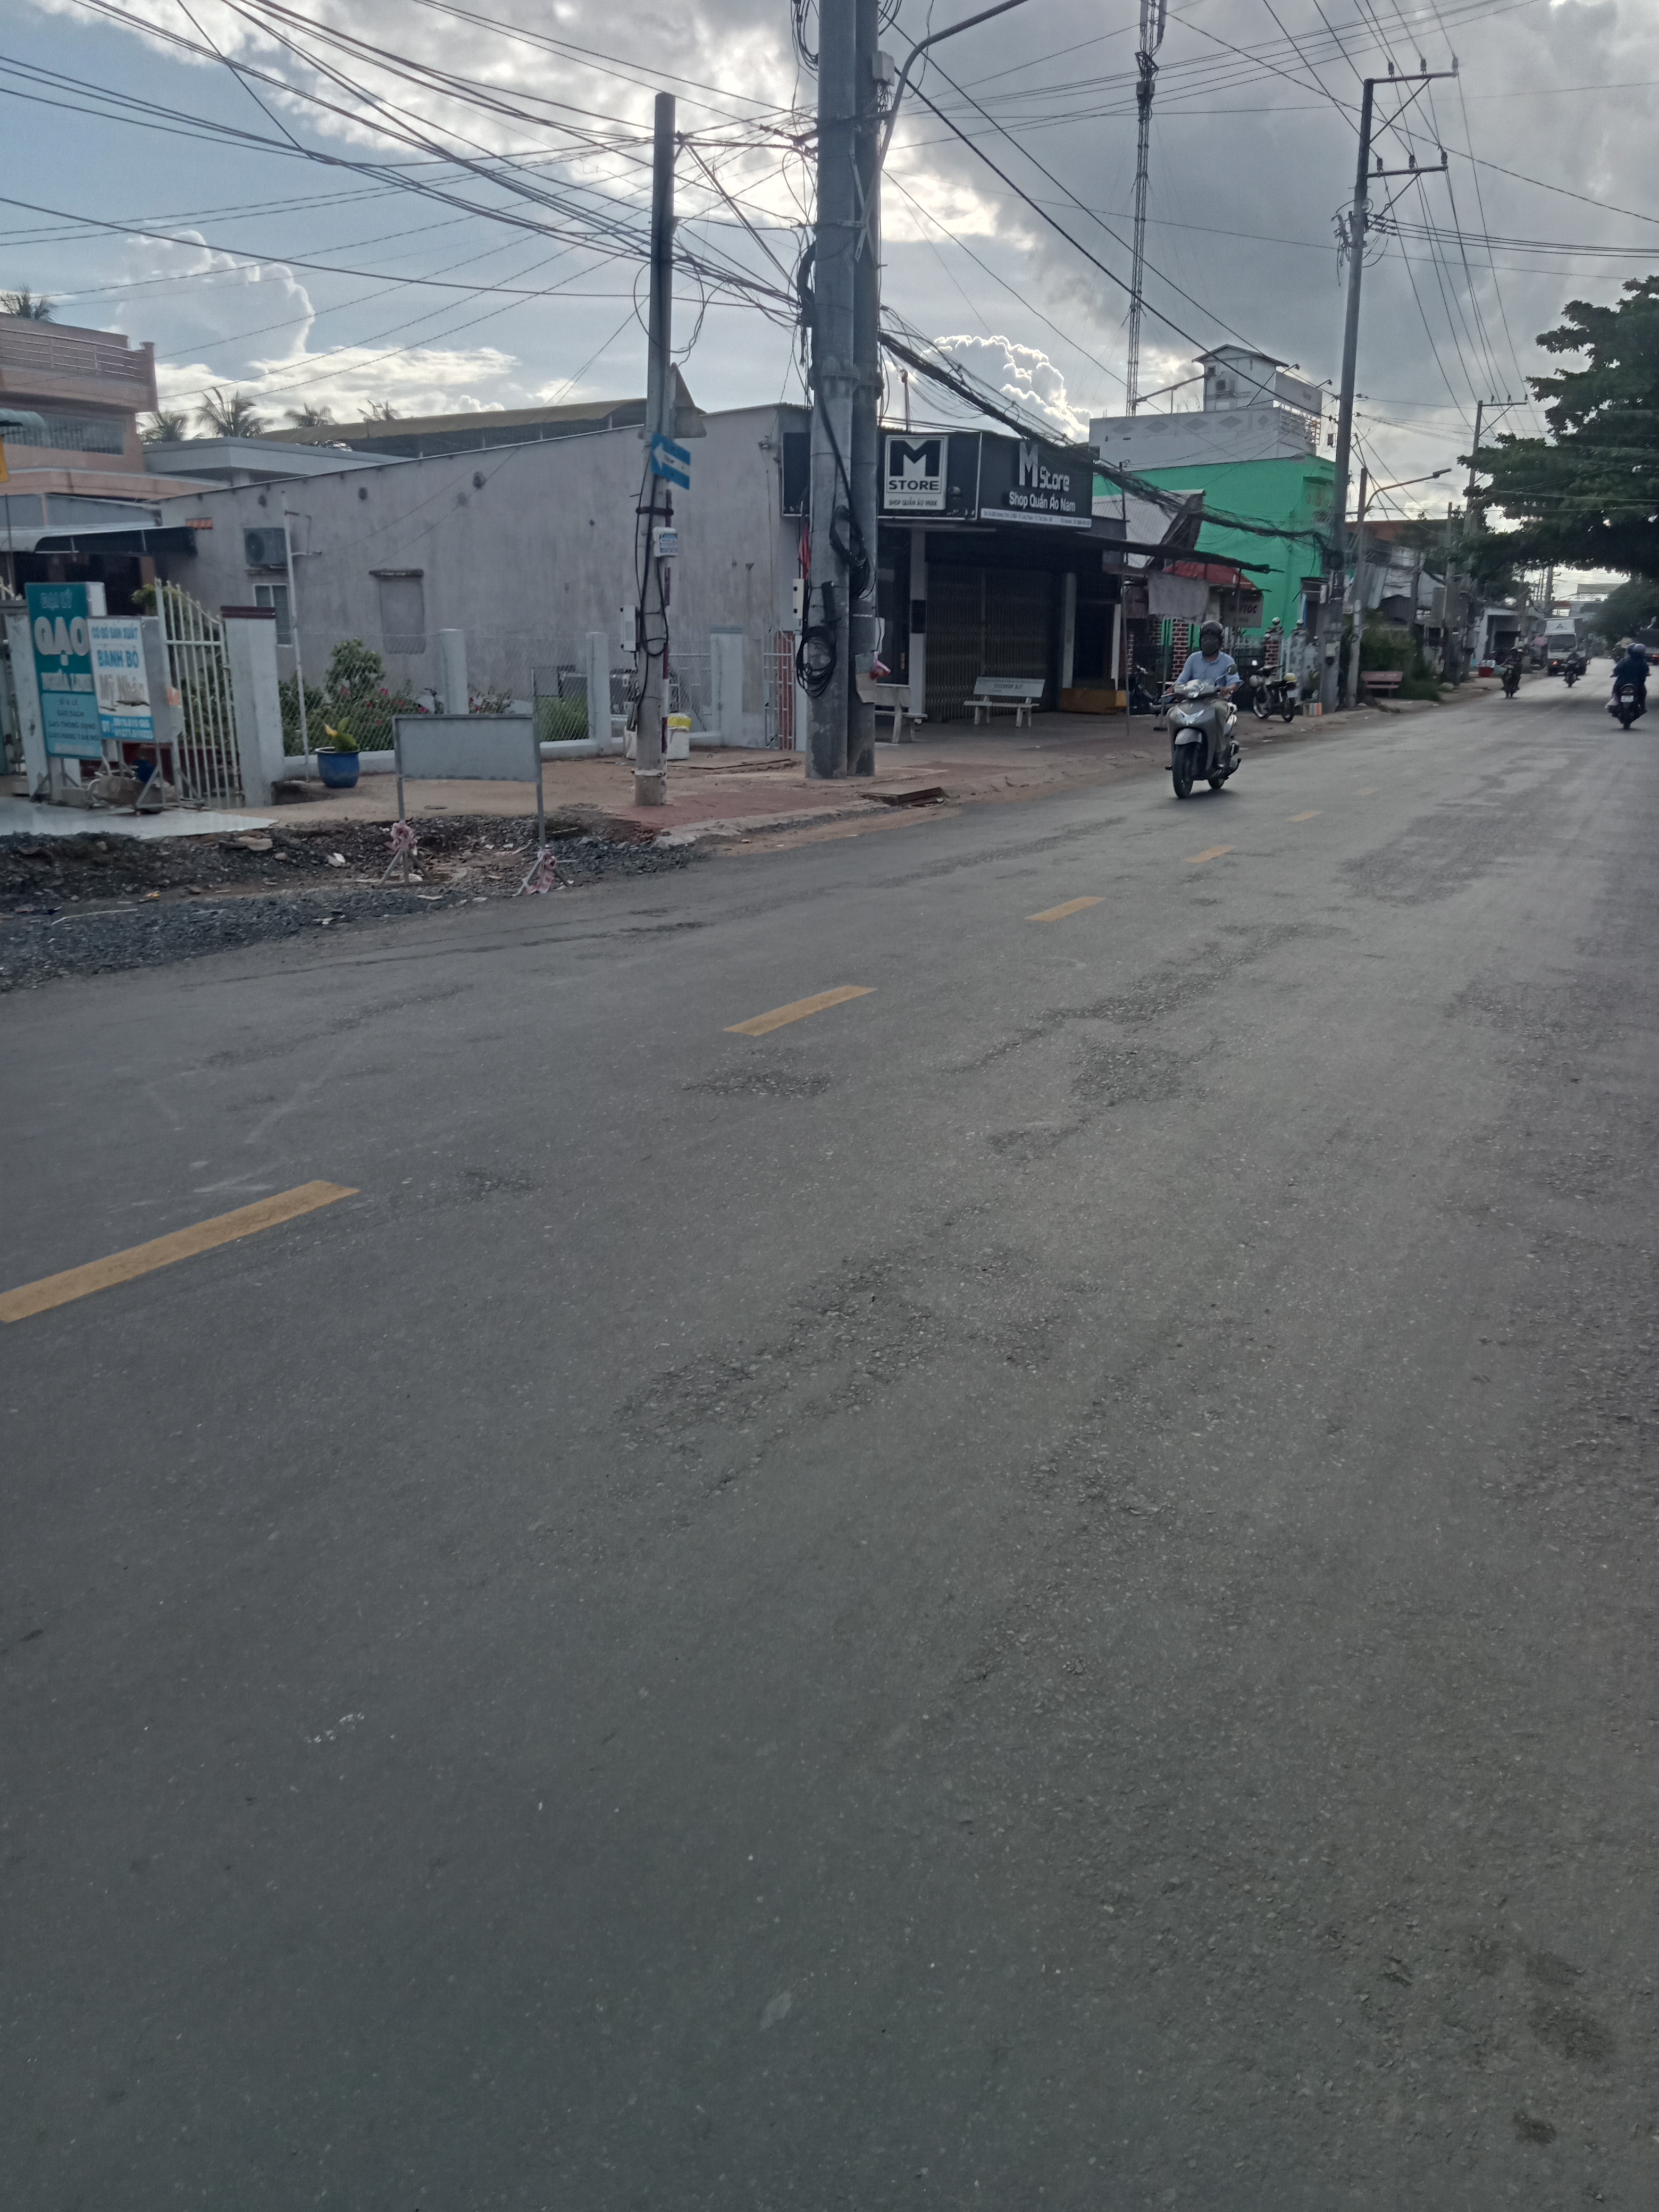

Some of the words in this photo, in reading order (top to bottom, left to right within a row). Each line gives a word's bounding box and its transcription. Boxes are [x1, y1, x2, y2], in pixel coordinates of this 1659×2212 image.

[1019, 442, 1038, 488] M
[889, 480, 939, 490] STORE
[1009, 491, 1028, 510] Shop
[1049, 493, 1059, 510] Áo
[1060, 498, 1076, 512] Nam
[34, 616, 90, 666] GẠO
